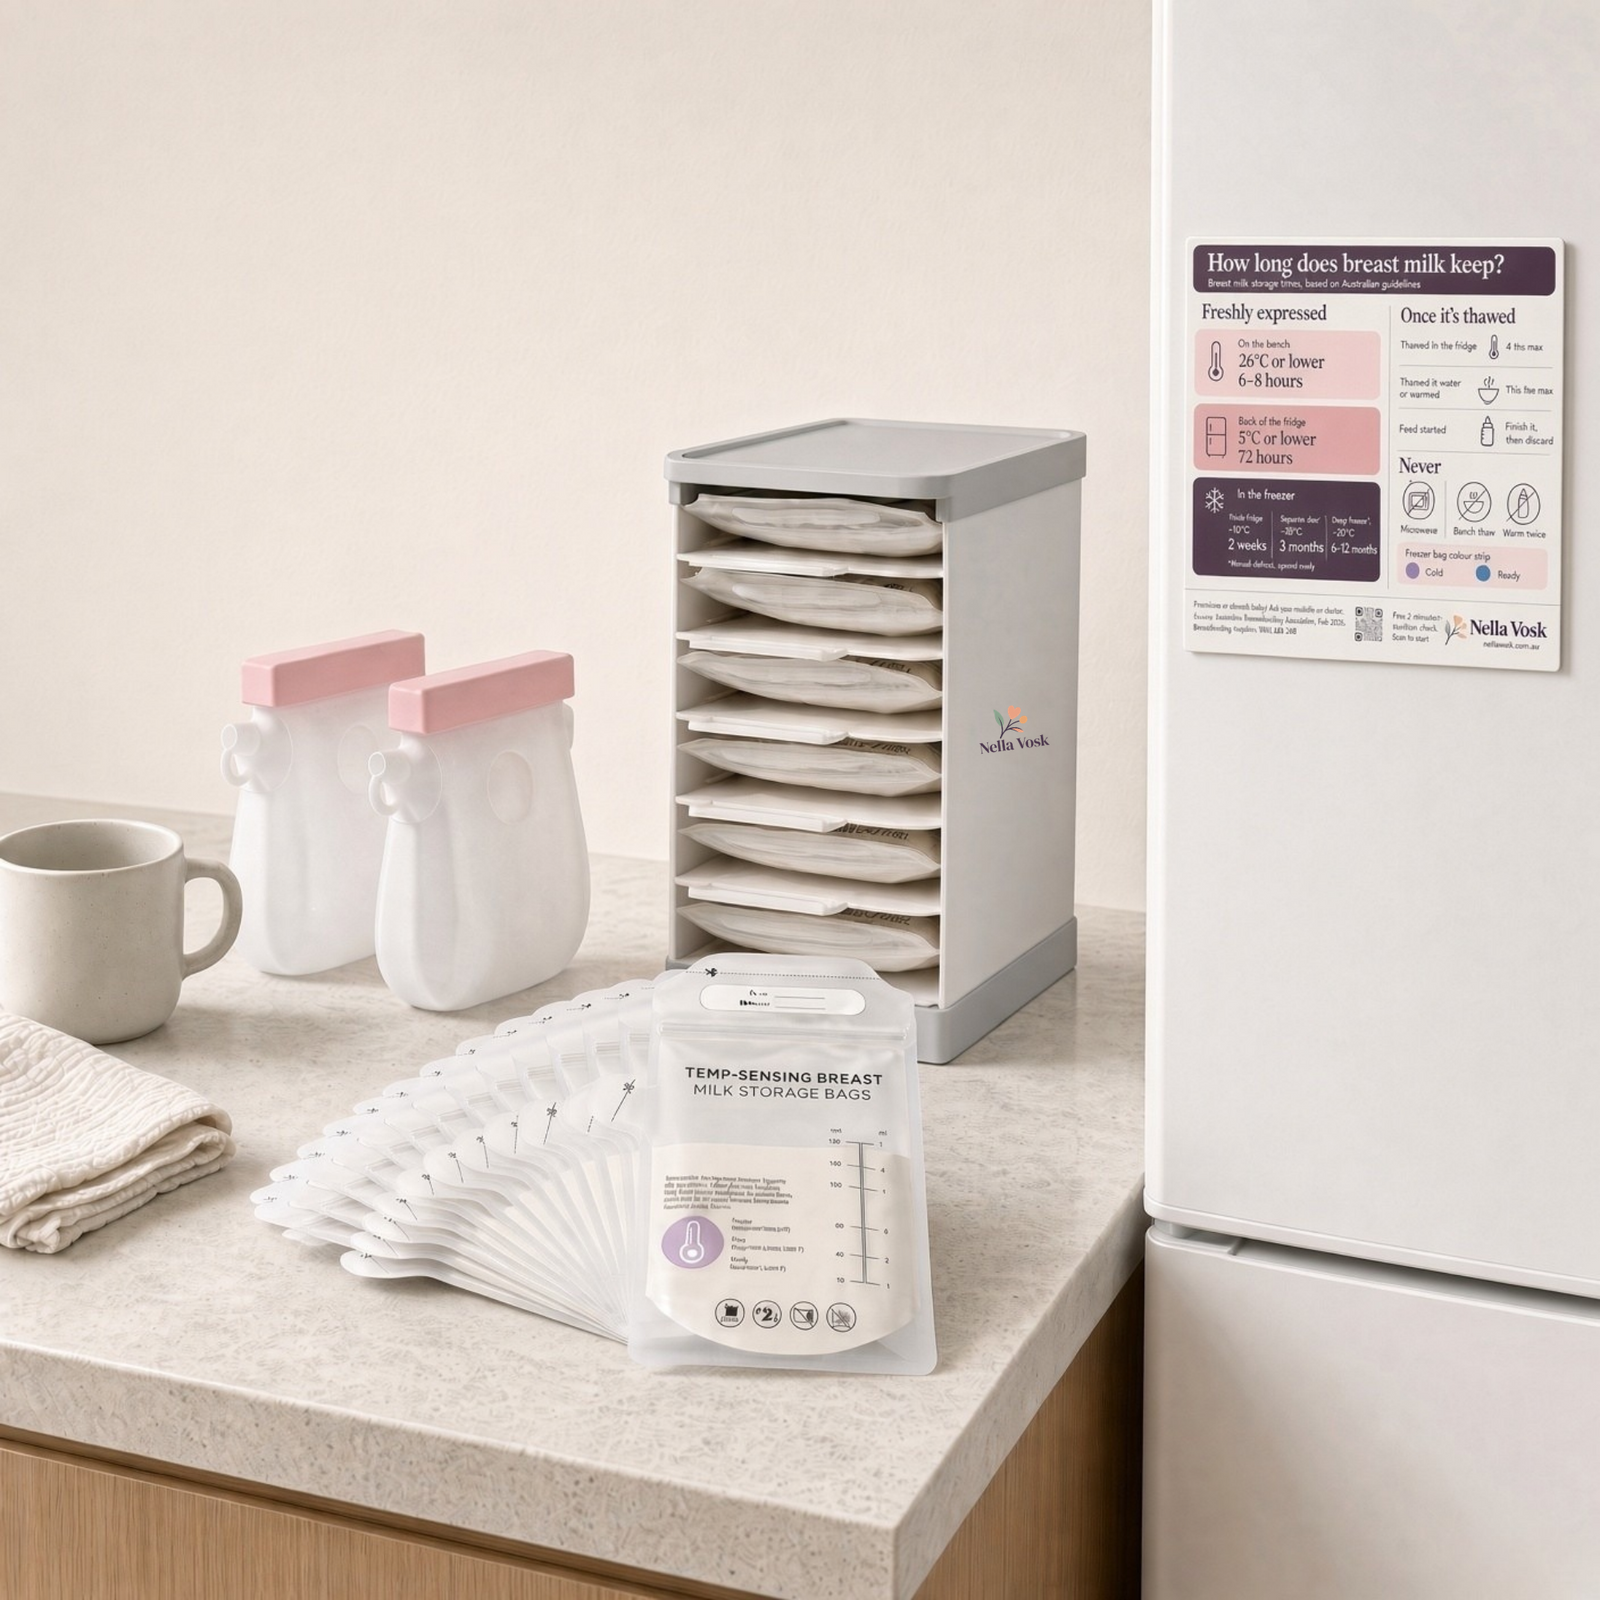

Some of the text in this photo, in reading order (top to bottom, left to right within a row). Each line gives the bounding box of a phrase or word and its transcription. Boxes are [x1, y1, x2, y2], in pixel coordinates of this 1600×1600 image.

[1207, 252, 1505, 280] How long does breast milk keep?
[1207, 278, 1231, 288] Breast
[1233, 278, 1249, 288] milk
[1251, 279, 1279, 291] storage
[1305, 278, 1328, 288] based
[1341, 279, 1380, 289] Australian
[1381, 279, 1421, 291] guidelines
[1202, 303, 1327, 325] Freshly expressed
[1401, 306, 1437, 324] Once
[1463, 307, 1516, 325] thawed
[1237, 338, 1290, 349] On the bench
[1431, 340, 1439, 350] in
[1440, 341, 1453, 350] the
[1455, 340, 1478, 353] fridge
[1505, 342, 1512, 351] 4
[1527, 344, 1544, 352] max
[1238, 353, 1325, 369] 26°C or lower
[1265, 372, 1303, 388] hours
[1399, 391, 1408, 399] or
[1505, 385, 1522, 394] This
[1258, 416, 1268, 426] of
[1268, 417, 1281, 427] the
[1283, 417, 1307, 429] fridge
[1399, 424, 1447, 435] Feed started
[1238, 430, 1316, 446] 5°C or lower
[1505, 434, 1524, 445] then
[1238, 449, 1293, 465] 72 hours
[1398, 456, 1442, 475] Never
[1237, 488, 1295, 500] In the freezer
[1227, 537, 1267, 551] 2 weeks
[1279, 539, 1324, 553] 3 months
[1351, 543, 1378, 555] months
[1448, 550, 1472, 560] colour
[1474, 551, 1491, 563] strip
[1425, 567, 1444, 577] Cold
[1469, 618, 1547, 638] Nella Vosk
[979, 734, 1050, 755] Nella Vosk
[685, 1066, 883, 1085] TEMP-SENSING BREAST
[693, 1084, 872, 1101] MILK STORAGE BAGS
